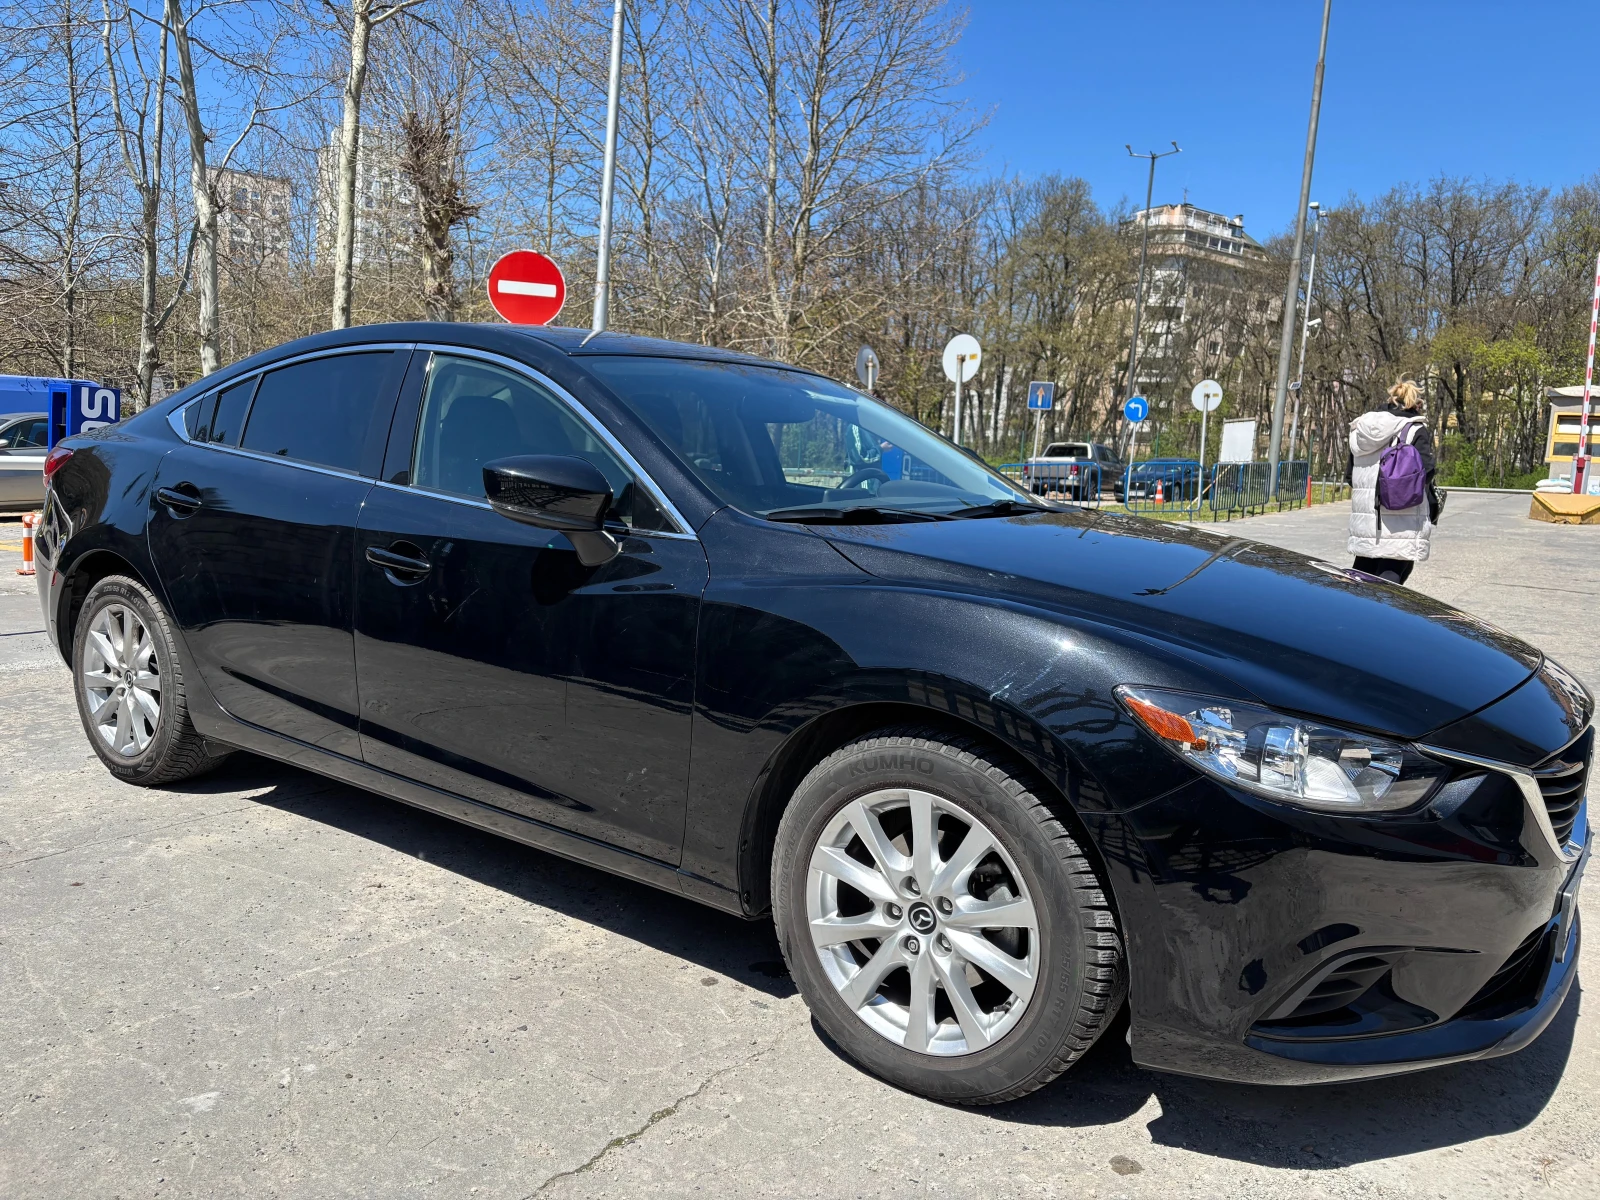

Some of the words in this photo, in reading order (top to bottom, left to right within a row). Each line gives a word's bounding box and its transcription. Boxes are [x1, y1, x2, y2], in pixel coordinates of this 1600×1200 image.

[848, 755, 934, 778] KUMHO
[1059, 934, 1071, 994] 225/55
[1026, 1029, 1051, 1064] 101V
